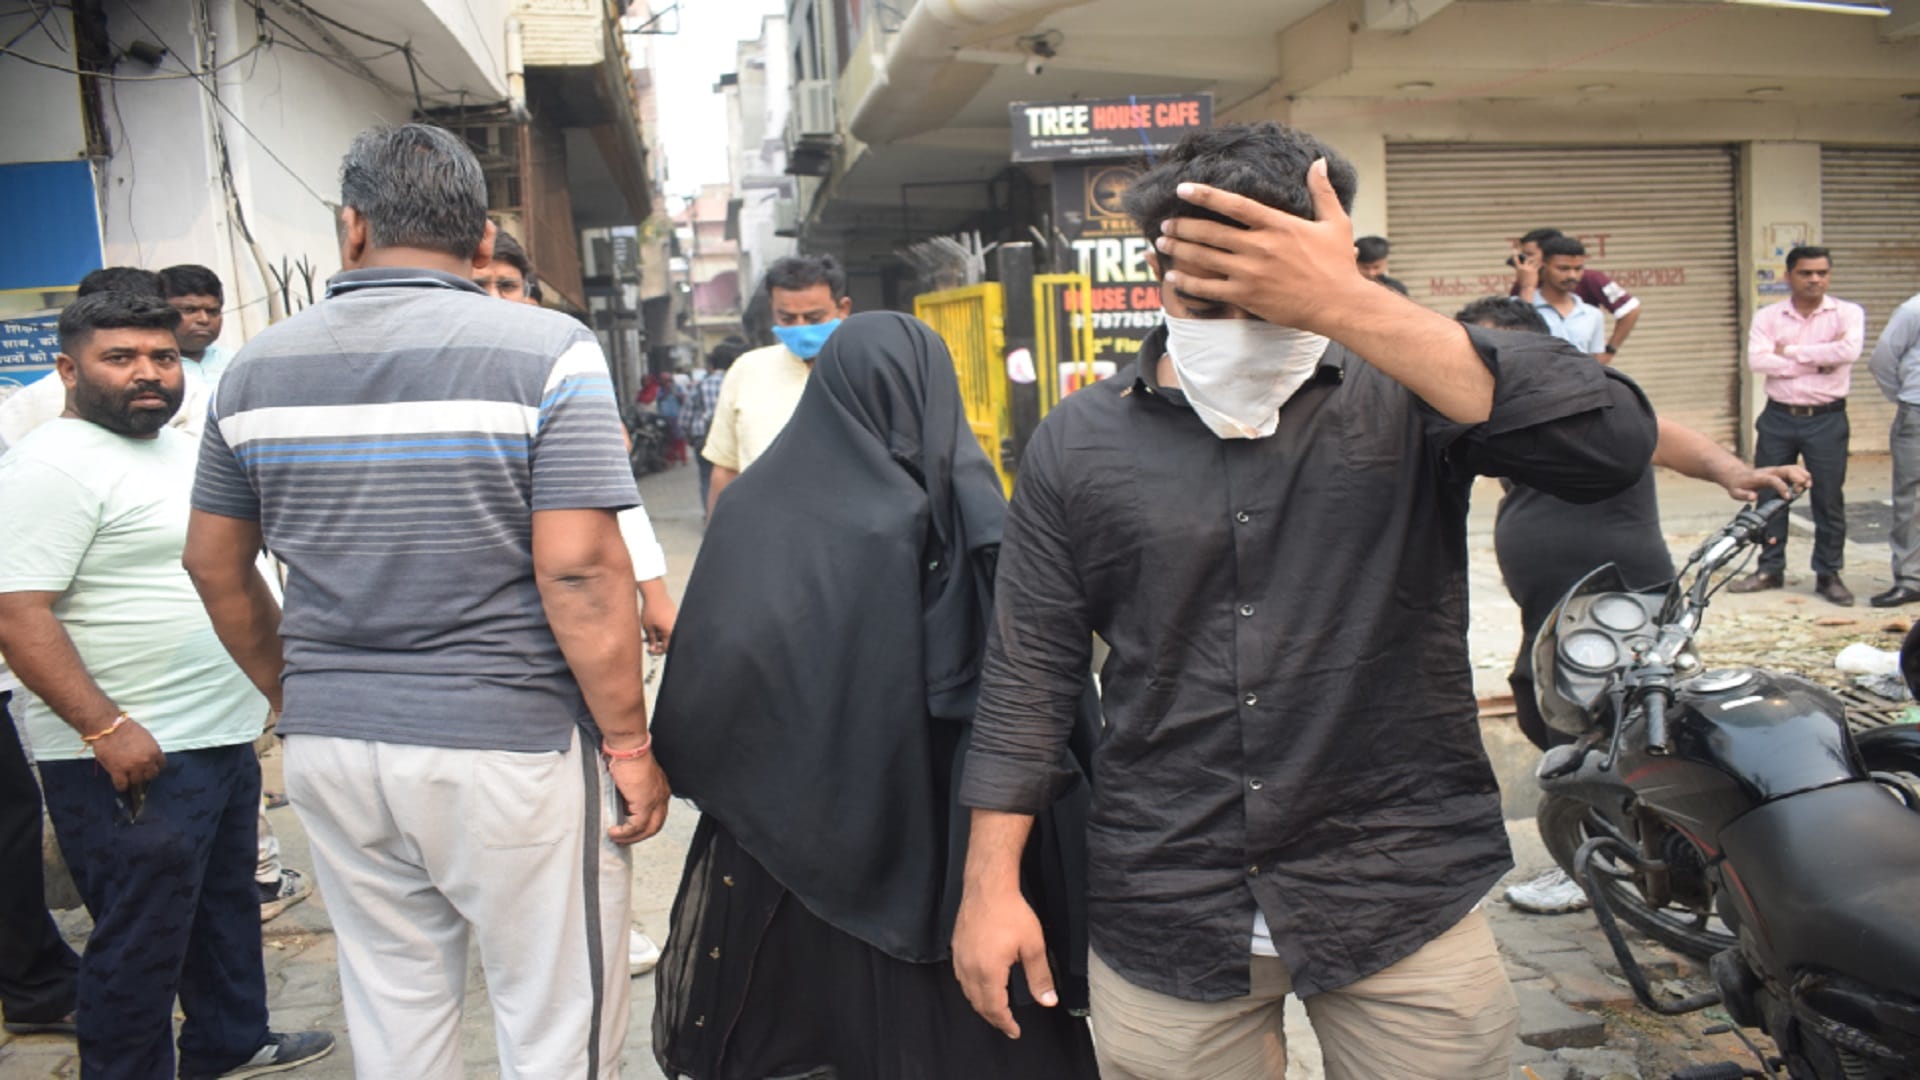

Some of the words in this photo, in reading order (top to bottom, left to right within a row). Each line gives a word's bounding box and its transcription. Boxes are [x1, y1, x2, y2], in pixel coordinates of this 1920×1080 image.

[1025, 106, 1090, 137] TREE
[1093, 105, 1152, 130] HOUSE
[1155, 101, 1200, 127] CAFE
